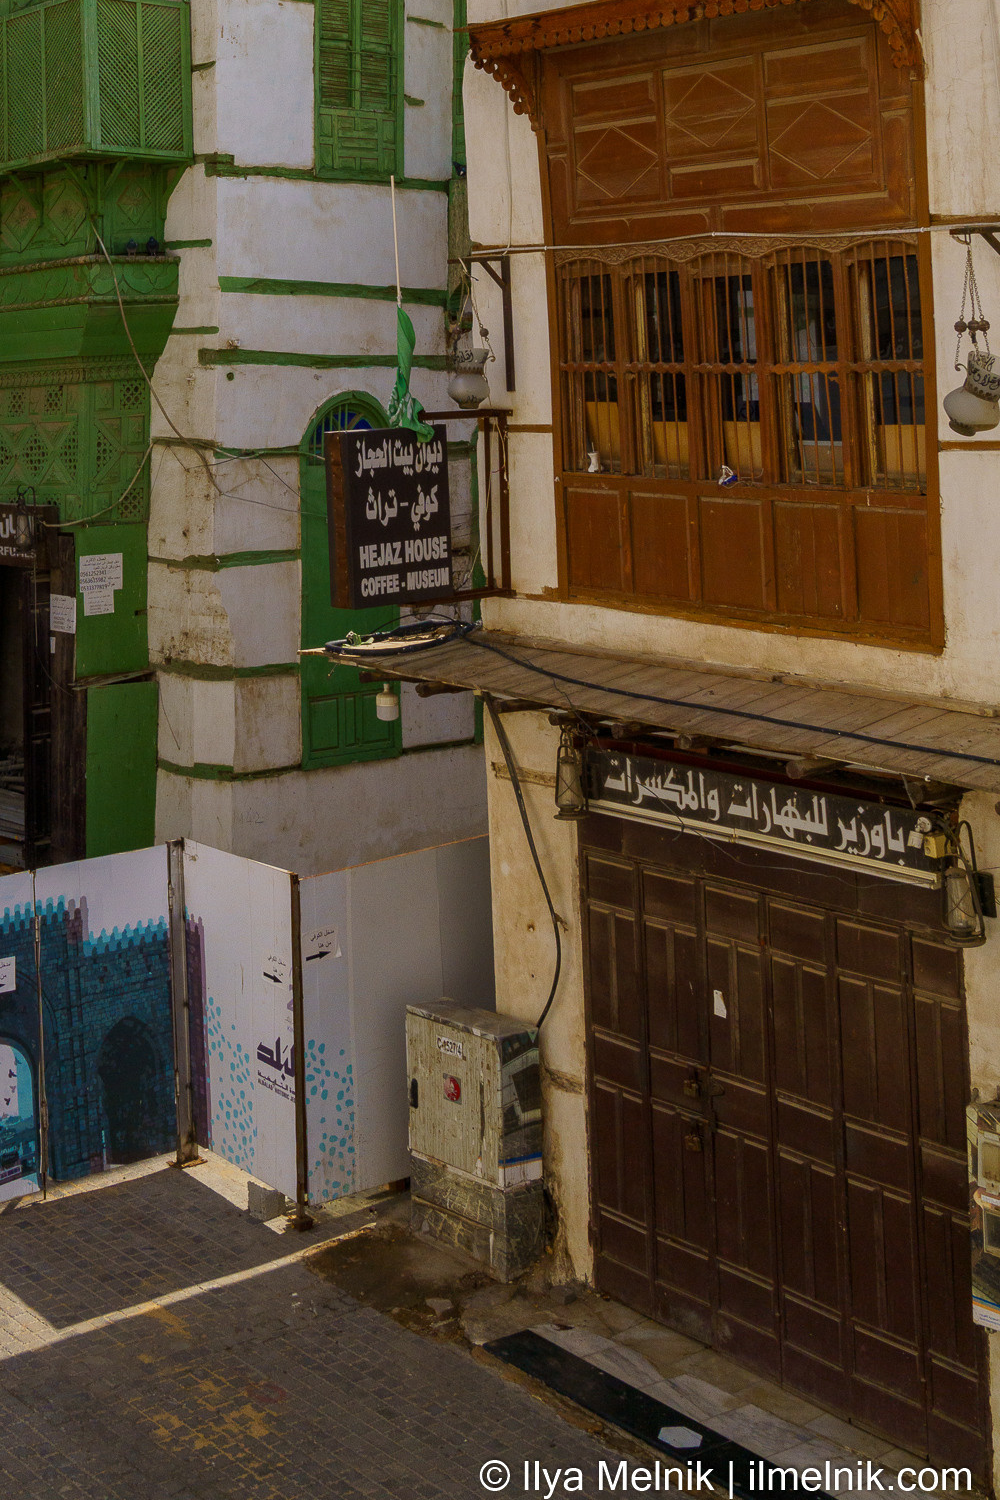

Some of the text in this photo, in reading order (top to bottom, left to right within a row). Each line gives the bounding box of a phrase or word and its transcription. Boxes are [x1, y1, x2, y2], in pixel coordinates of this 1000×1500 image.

[354, 437, 443, 478] ديوان بيت الحجاز
[366, 486, 398, 527] تراث
[411, 484, 439, 531] كوفي
[359, 535, 448, 569] HEJAZ HOUSE
[361, 574, 400, 597] COFFEE
[406, 567, 450, 591] MUSEUM
[604, 757, 906, 867] باوزير للبهارات والمكسرات
